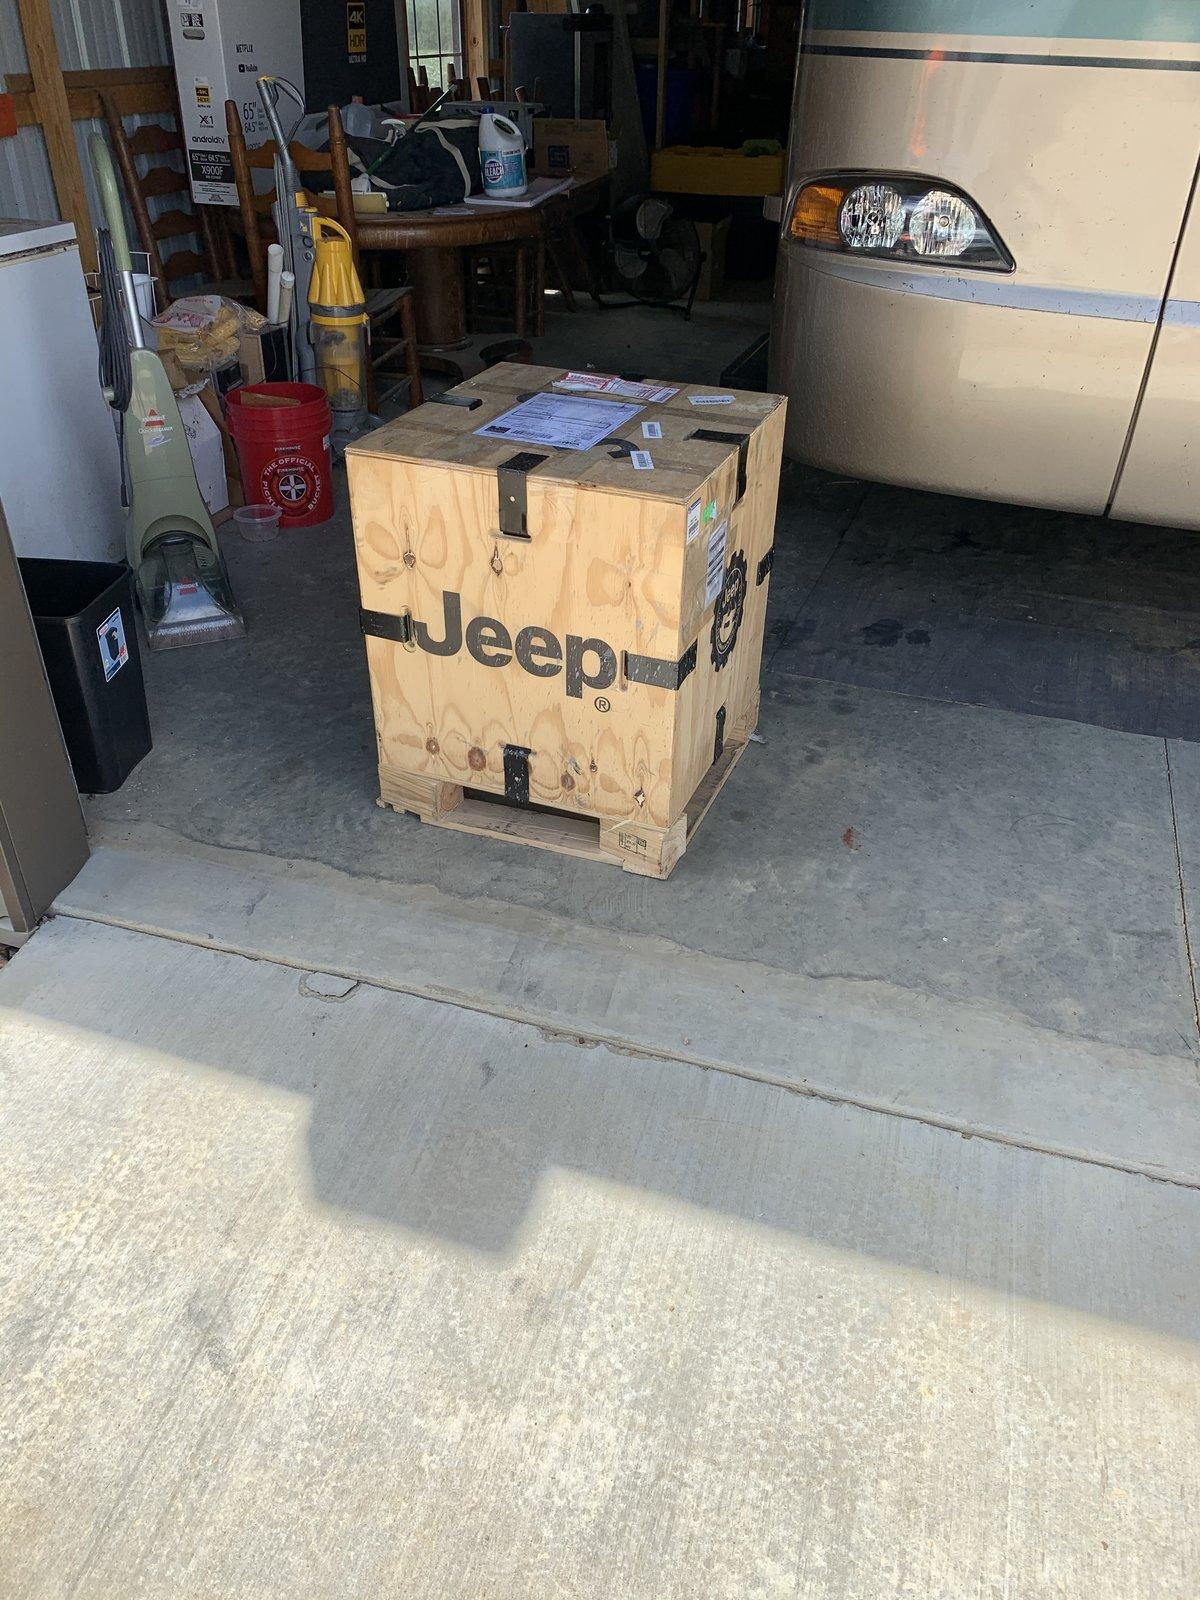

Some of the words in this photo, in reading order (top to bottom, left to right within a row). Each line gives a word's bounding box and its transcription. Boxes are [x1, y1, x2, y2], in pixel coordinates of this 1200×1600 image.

[350, 10, 364, 23] 4K
[350, 32, 365, 48] HDR
[236, 44, 254, 53] NETFLIX
[201, 165, 224, 176] X900F
[484, 165, 505, 177] BLEACH
[263, 461, 279, 477] THE
[278, 456, 316, 473] OFFICIAL
[307, 474, 322, 511] BUCKET
[722, 577, 740, 609] Jeep
[412, 589, 618, 699] Jeep
